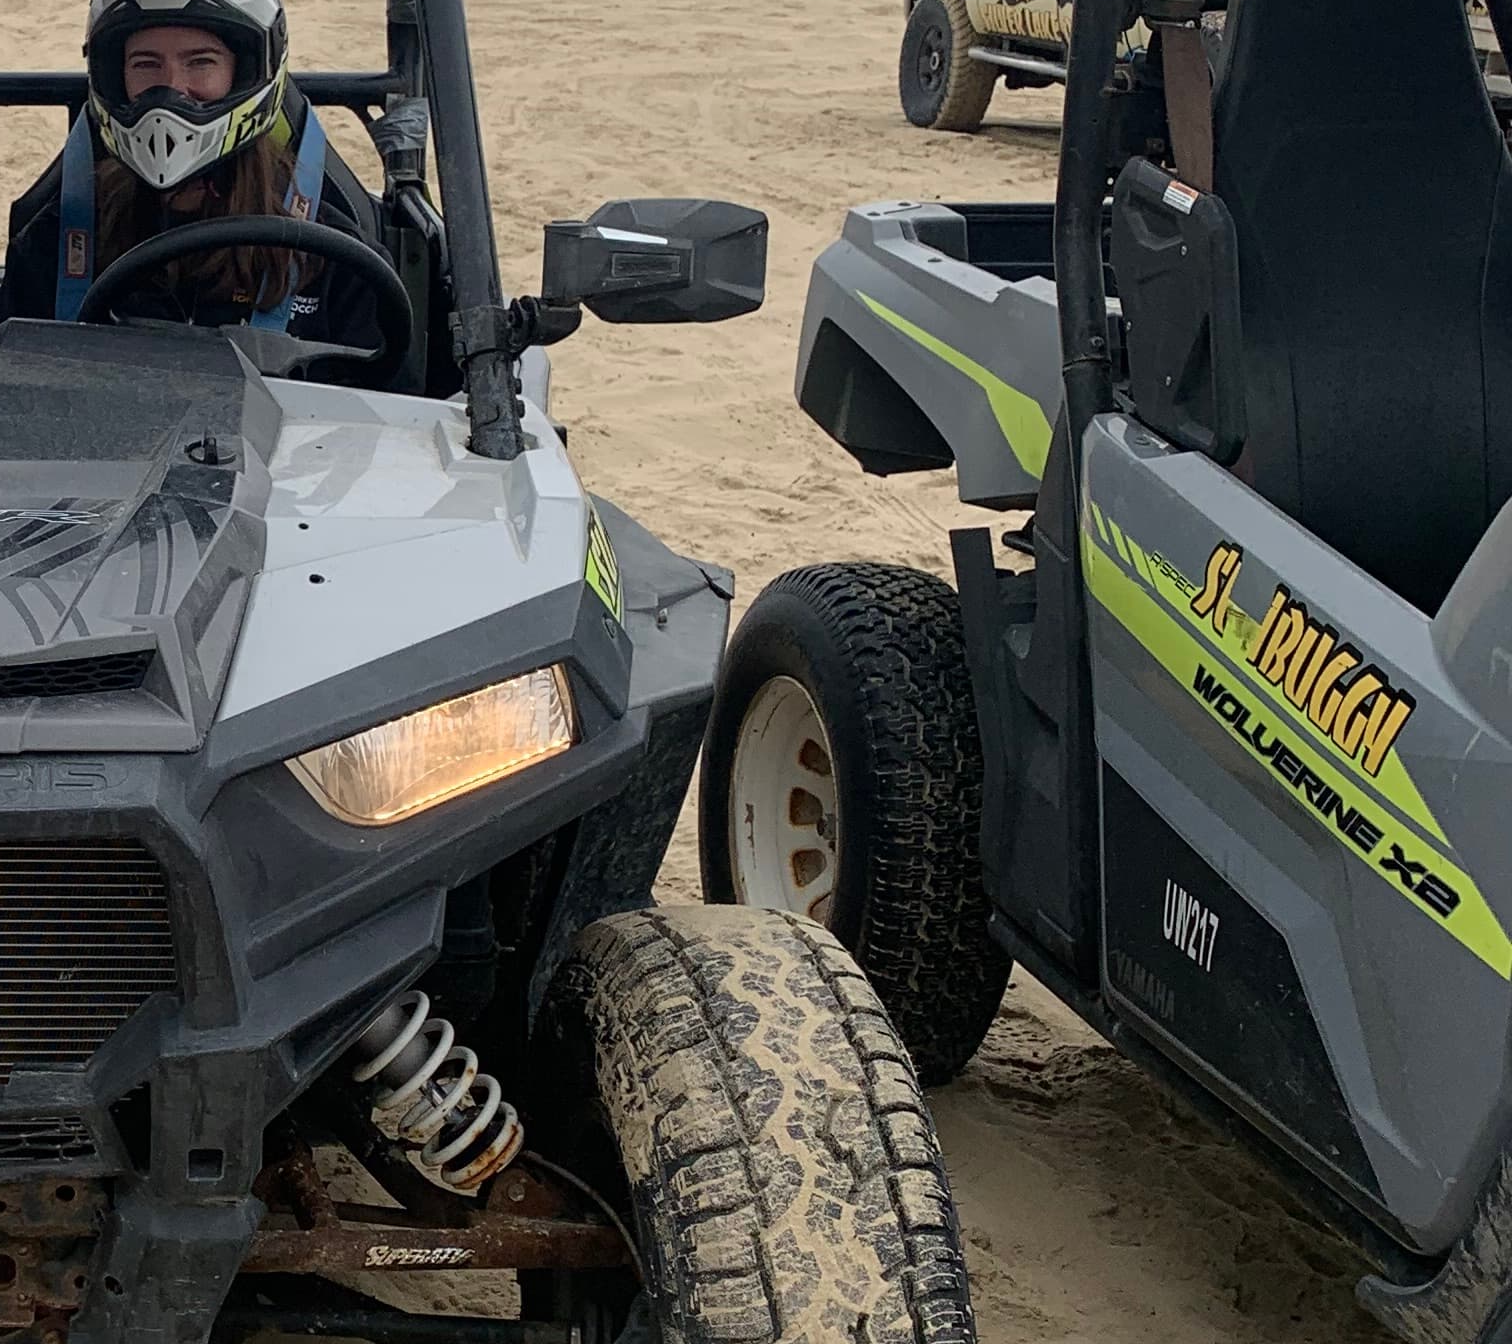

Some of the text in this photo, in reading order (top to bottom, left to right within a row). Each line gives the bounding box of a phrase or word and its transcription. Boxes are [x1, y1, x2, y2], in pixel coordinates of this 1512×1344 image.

[1025, 8, 1063, 42] LAKE
[1192, 664, 1461, 918] WOLVERINE X2
[1163, 878, 1220, 973] UW217
[1109, 949, 1175, 1022] YAMAHA
